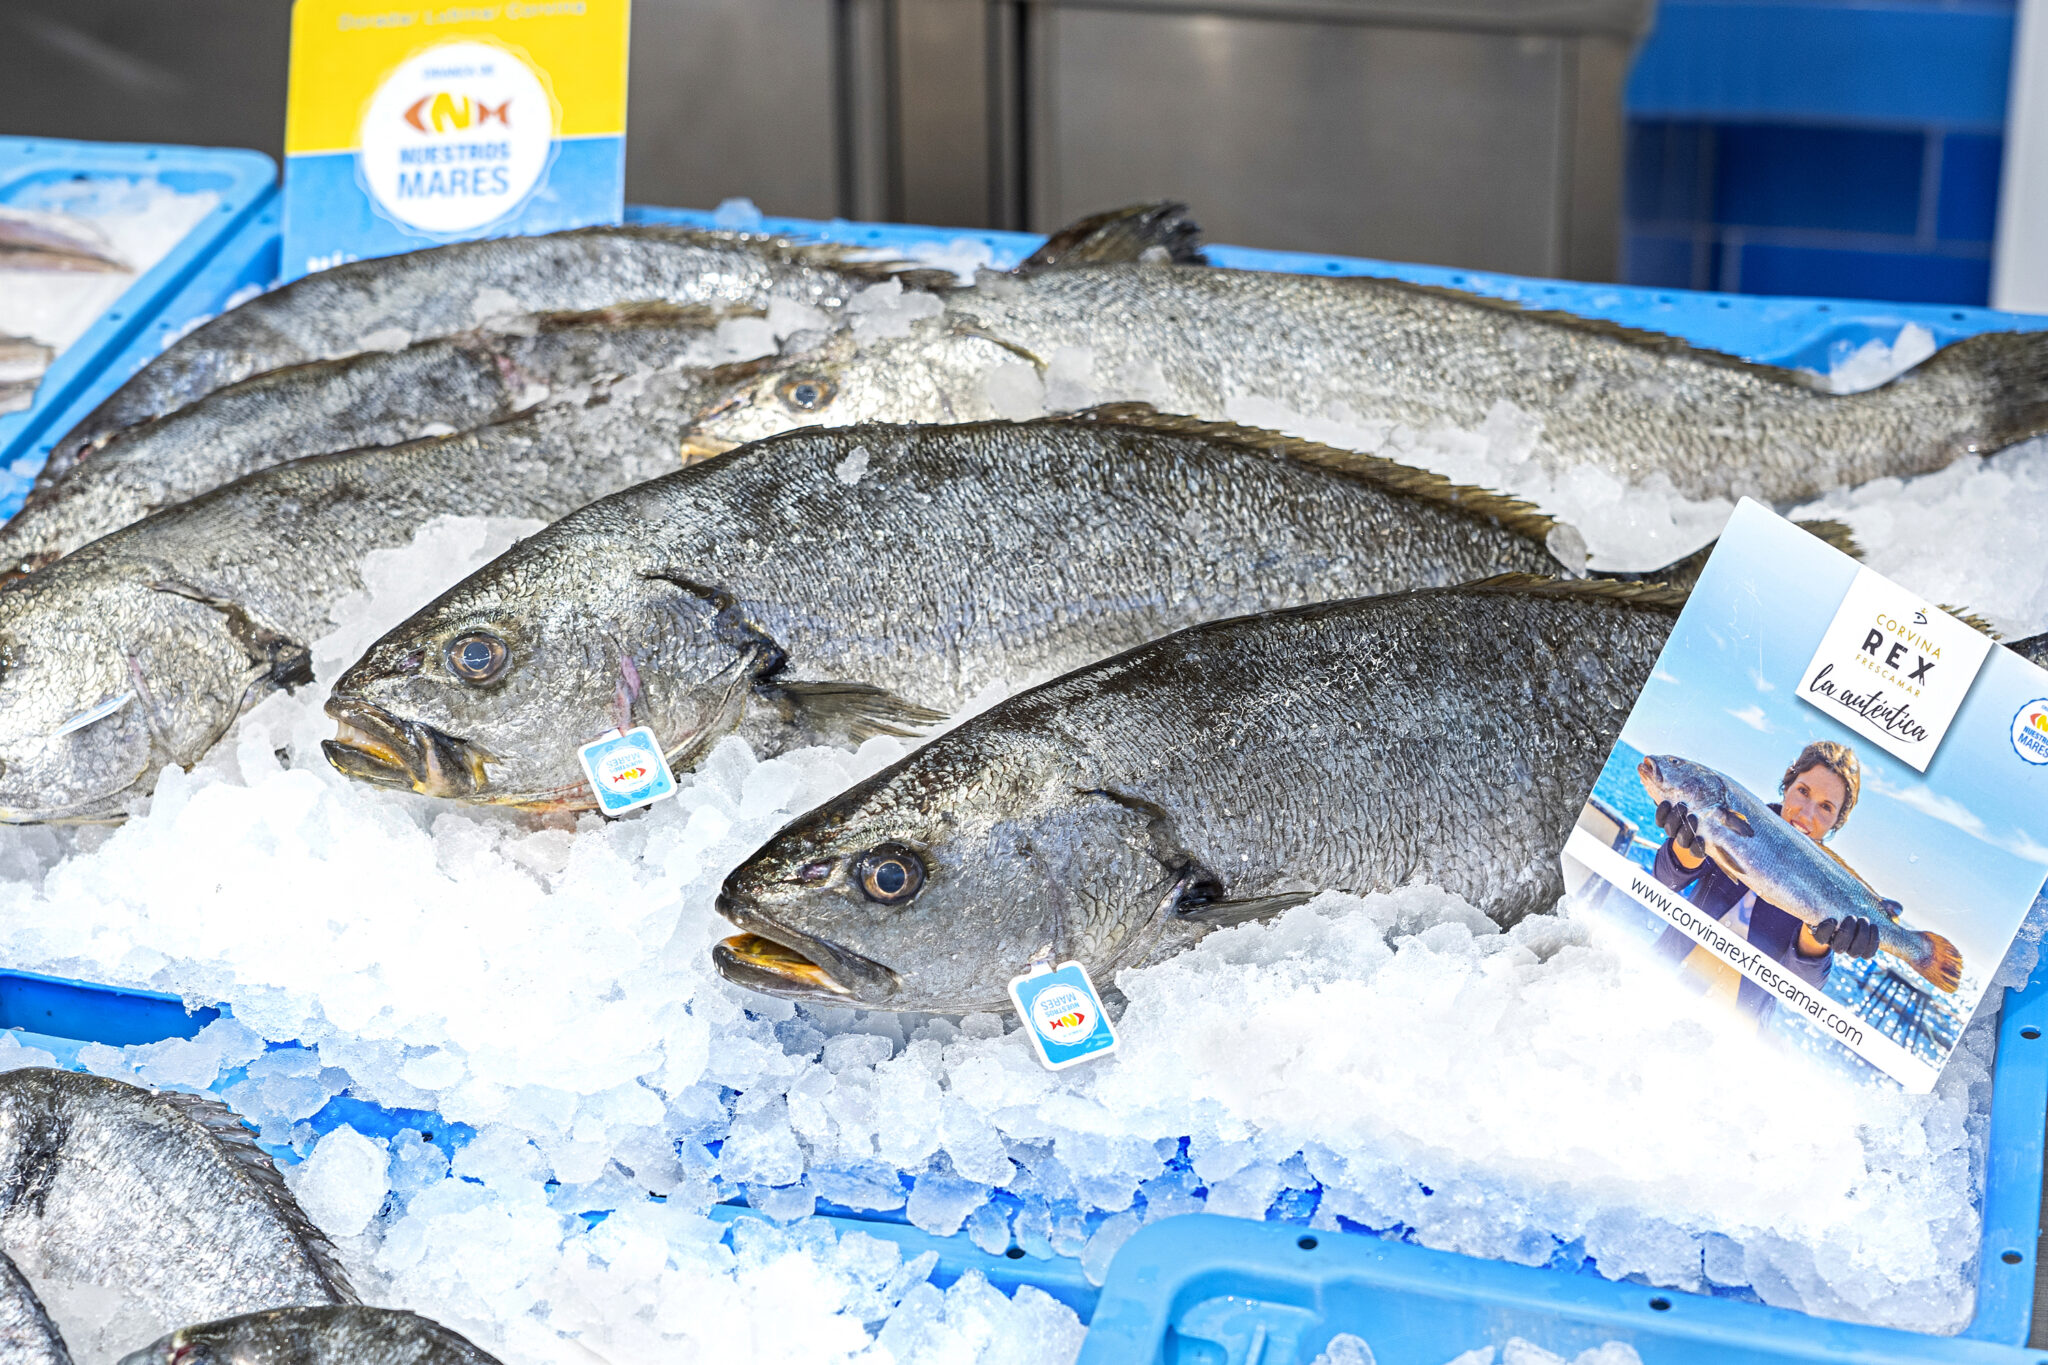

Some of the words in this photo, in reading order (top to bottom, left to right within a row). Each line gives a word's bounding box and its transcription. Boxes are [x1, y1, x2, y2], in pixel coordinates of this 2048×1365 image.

[399, 142, 511, 164] NUESTROS
[397, 166, 509, 199] MARES
[1876, 613, 1941, 660] CORVINA
[1855, 653, 1921, 698] FRESCAMAR
[1861, 628, 1936, 686] REX
[1809, 663, 1838, 696] la
[1840, 690, 1928, 742] auténtica
[606, 752, 641, 769] MARES
[1630, 876, 1864, 1046] www.corvinarexfrescamar.com
[1040, 991, 1077, 1011] MARES
[1044, 1001, 1080, 1018] NUESTROS
